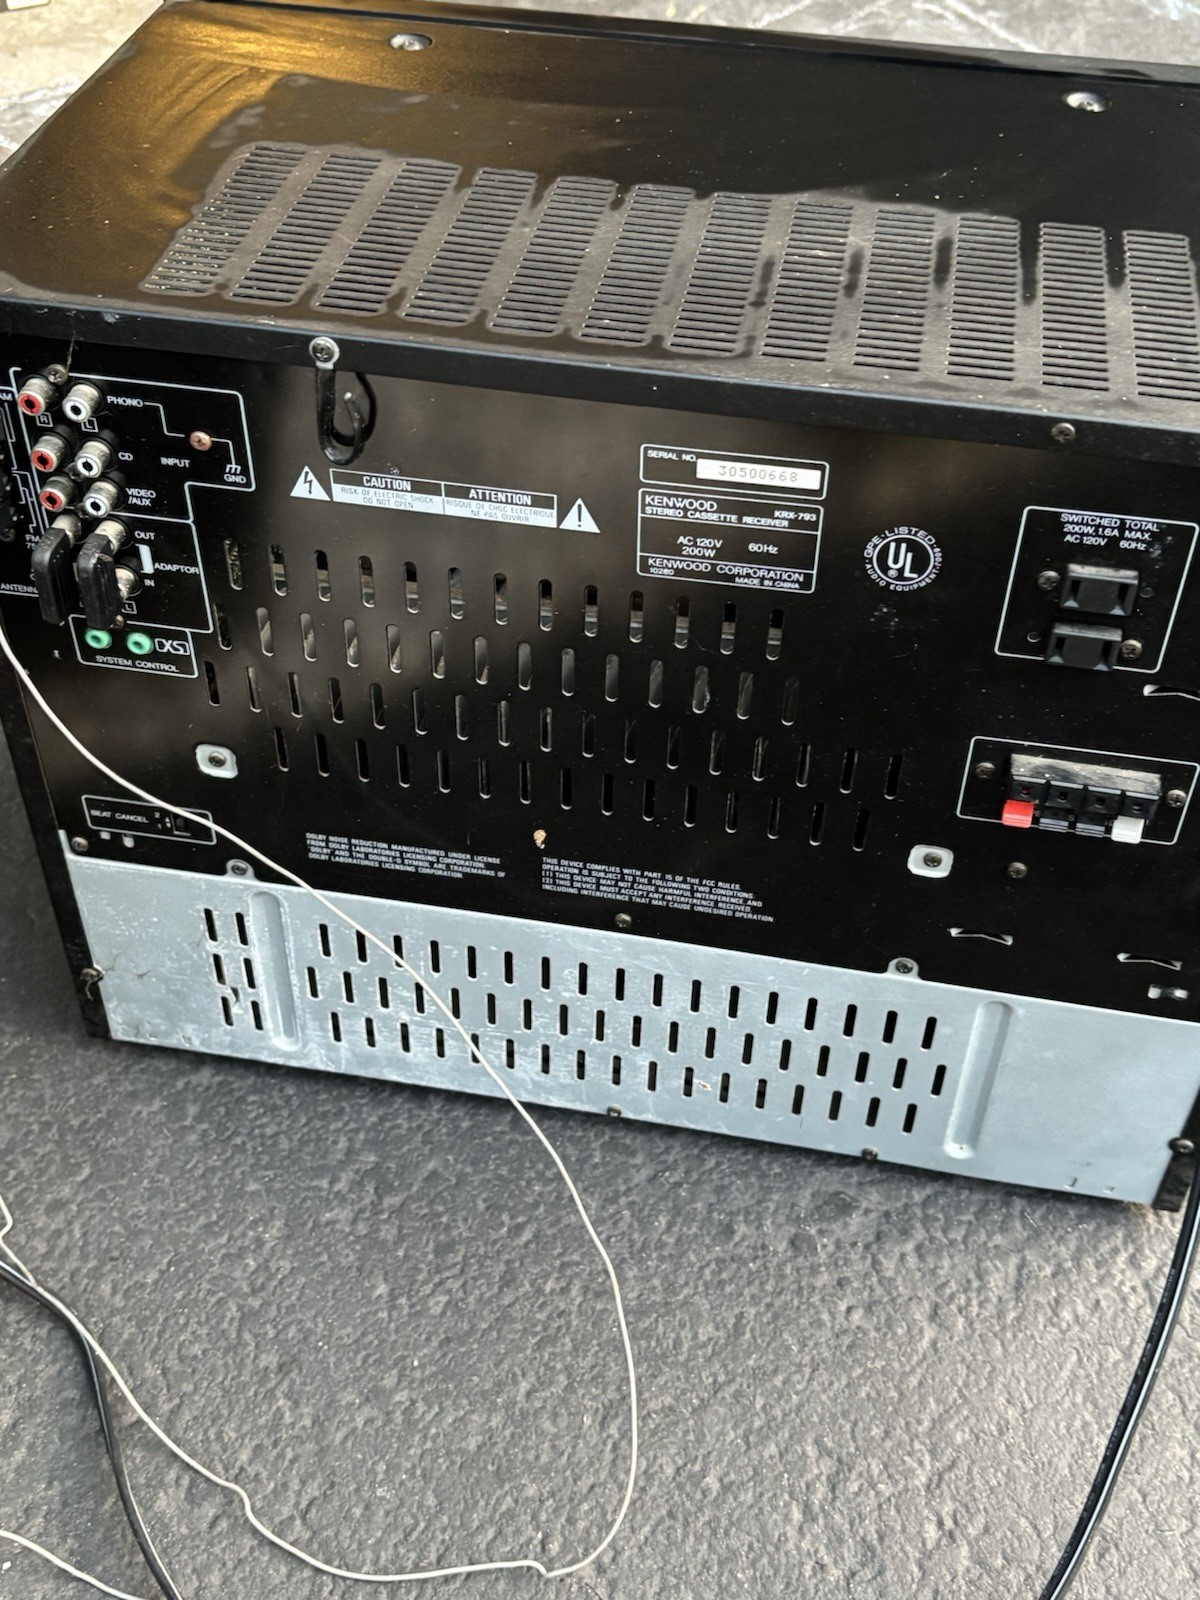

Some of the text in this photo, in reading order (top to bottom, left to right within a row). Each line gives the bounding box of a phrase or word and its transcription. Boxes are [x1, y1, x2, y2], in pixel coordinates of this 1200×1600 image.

[0, 392, 12, 401] AM
[107, 395, 144, 407] PHONO
[40, 415, 48, 423] R
[118, 452, 133, 461] CD
[161, 457, 190, 468] INPUT
[647, 450, 697, 462] SERIAL NO.
[224, 474, 247, 484] GND
[718, 465, 798, 482] 30500668
[363, 476, 411, 491] CAUTION
[126, 487, 156, 498] VIDEO
[128, 496, 151, 506] /AUX
[341, 486, 359, 494] RISK
[374, 491, 407, 499] ELECTRIC
[469, 488, 531, 505] ATTENTION
[446, 499, 473, 508] RISQUE
[511, 507, 554, 518] ELECTRIQUE
[645, 495, 717, 512] KENWOOD
[501, 513, 529, 522] OUVRIR
[645, 506, 789, 527] STEREO CASSETTE RECEIVER
[774, 510, 817, 521] KRX-793
[1060, 513, 1160, 532] SWITCHED TOTAL
[135, 530, 155, 540] OUT
[864, 535, 882, 558] GPE
[885, 526, 936, 545] LISTED
[1064, 534, 1146, 551] AC 120V 60Hz
[1098, 527, 1119, 537] 1.6A
[1124, 532, 1152, 541] MAX.
[677, 536, 778, 554] AC 120V 60Hz
[682, 546, 716, 557] 200W
[154, 562, 199, 575] ADAPTOR
[887, 542, 918, 578] UL
[648, 557, 804, 581] KENWOOD CORPORATION
[865, 564, 939, 591] AUDIO EQUIPMENT
[0, 583, 38, 593] ANTENN
[144, 579, 155, 587] IN
[735, 576, 761, 586] MADE
[774, 581, 800, 590] CHINA
[95, 655, 180, 672] SYSTEM CONTROL
[90, 810, 149, 823] BEAT CANCEL
[306, 833, 500, 864] DOLBY NOISE REDUCTION MANUFACTURED UNDER LICENSE
[307, 839, 325, 848] FROM
[329, 842, 349, 851] DOLBY
[352, 845, 400, 857] LABORATORIES
[403, 852, 437, 862] LICENSING
[309, 852, 329, 861] DOLBY
[331, 855, 379, 867] LABORATORIES
[382, 862, 415, 872] LICENSING
[335, 849, 349, 857] AND
[369, 854, 401, 864] DOUBLE-D
[404, 858, 429, 868] SYMBOL
[433, 862, 446, 870] ARE
[450, 864, 495, 876] TRADEMARKS
[542, 864, 579, 875] OPERATION
[591, 871, 620, 881] SUBJECT
[636, 877, 648, 885] THE
[652, 879, 690, 890] FOLLOWING
[693, 885, 710, 893] TWO
[543, 857, 558, 865] THIS
[560, 859, 583, 868] DEVICE
[586, 863, 620, 873] COMPLIES
[622, 868, 641, 876] WITH
[644, 871, 661, 879] PART
[718, 881, 741, 890] RULES.
[555, 873, 570, 881] THIS
[573, 875, 596, 884] DEVICE
[600, 879, 615, 887] MAY
[618, 881, 631, 889] NOT
[634, 883, 655, 892] CAUSE
[658, 887, 691, 897] HARMFUL
[747, 899, 762, 907] AND
[555, 879, 571, 887] THIS
[573, 882, 596, 891] DEVICE
[600, 885, 617, 894] MUST
[621, 888, 647, 898] ACCEPT
[648, 892, 663, 900] ANY
[665, 894, 715, 907] INTERFERENCE
[542, 885, 578, 894] INCLUDING
[580, 890, 629, 901] INTERFERENCE
[651, 899, 667, 907] MAY
[669, 902, 691, 910] CAUSE
[694, 905, 733, 916] UNDESIRED
